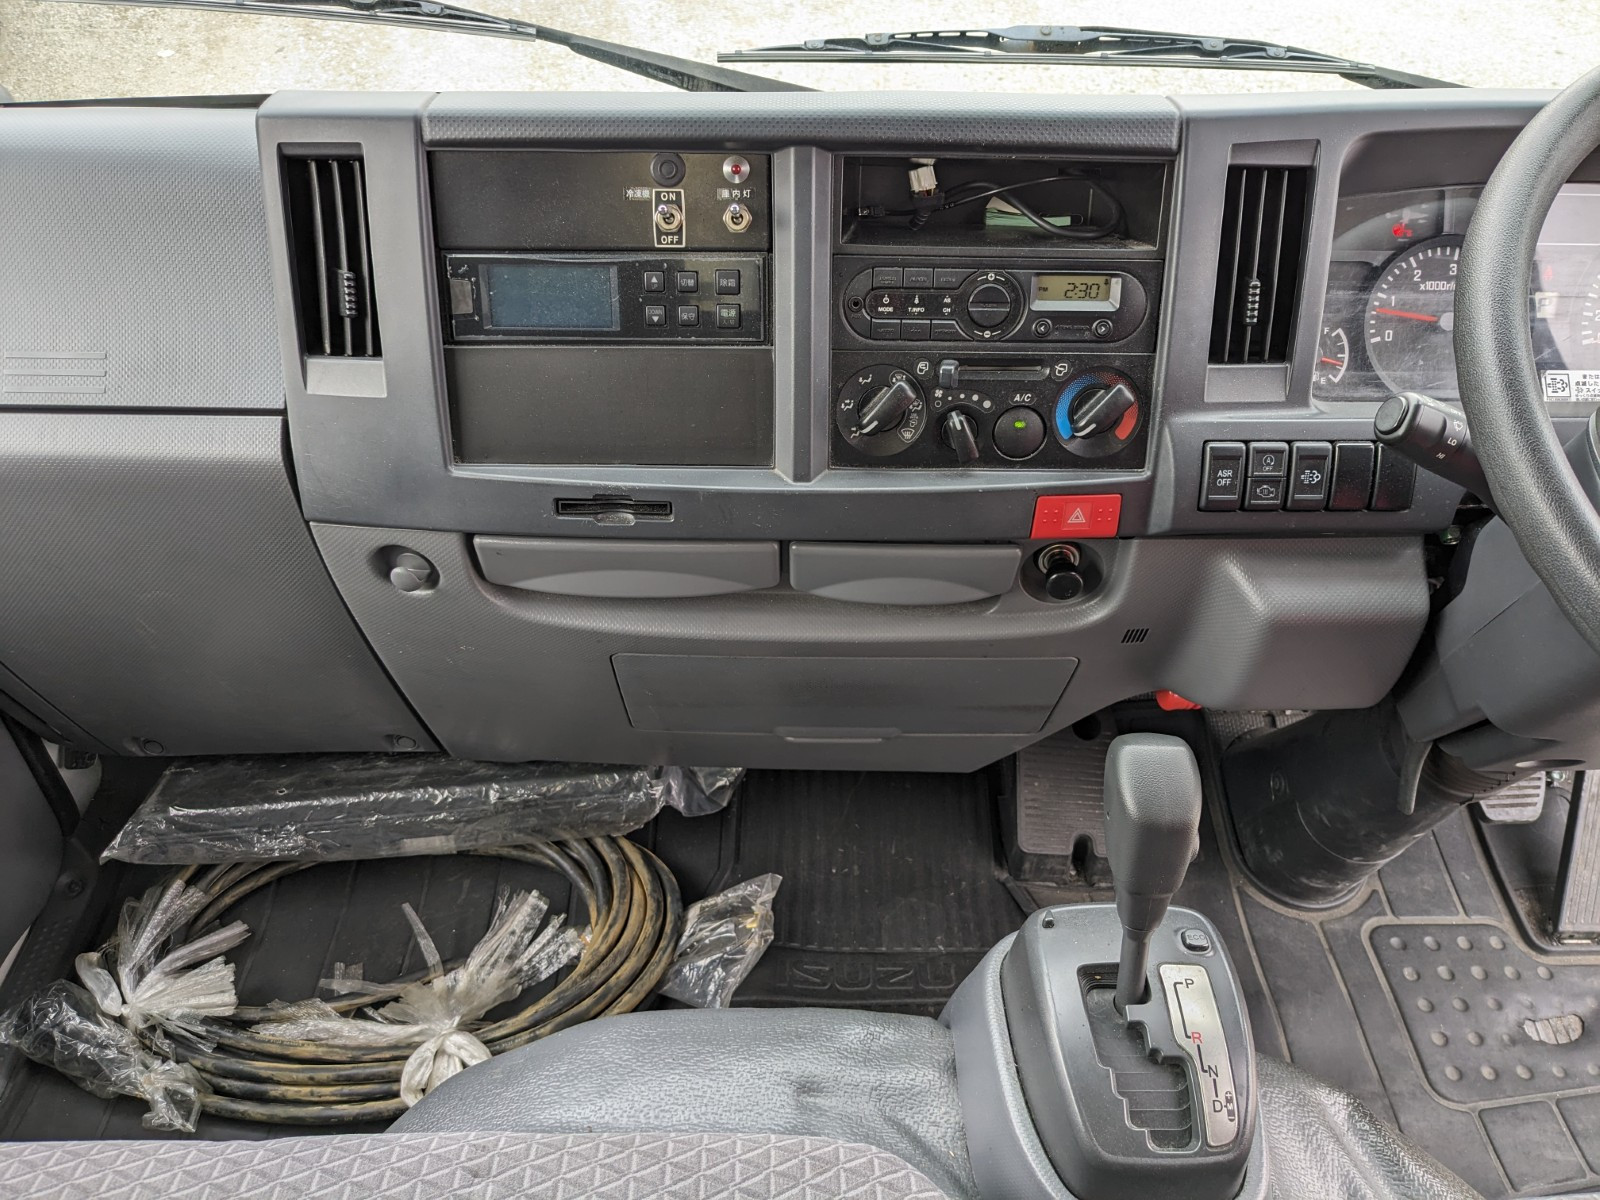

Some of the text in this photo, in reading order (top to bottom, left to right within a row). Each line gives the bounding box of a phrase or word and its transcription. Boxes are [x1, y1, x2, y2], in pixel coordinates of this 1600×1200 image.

[660, 192, 676, 201] ON
[660, 235, 679, 244] OFF
[1449, 263, 1458, 275] 3
[1413, 269, 1422, 282] 2
[1063, 282, 1100, 299] 2:30
[1390, 295, 1396, 307] 1
[1323, 327, 1330, 335] F
[1384, 330, 1393, 342] 0
[1013, 393, 1032, 402] A/C
[1446, 437, 1458, 447] LO
[1216, 469, 1233, 478] ASR
[1216, 478, 1232, 487] OFF
[1184, 978, 1195, 989] P
[1190, 1031, 1203, 1044] R
[1207, 1064, 1219, 1078] N
[1212, 1100, 1224, 1113] D
